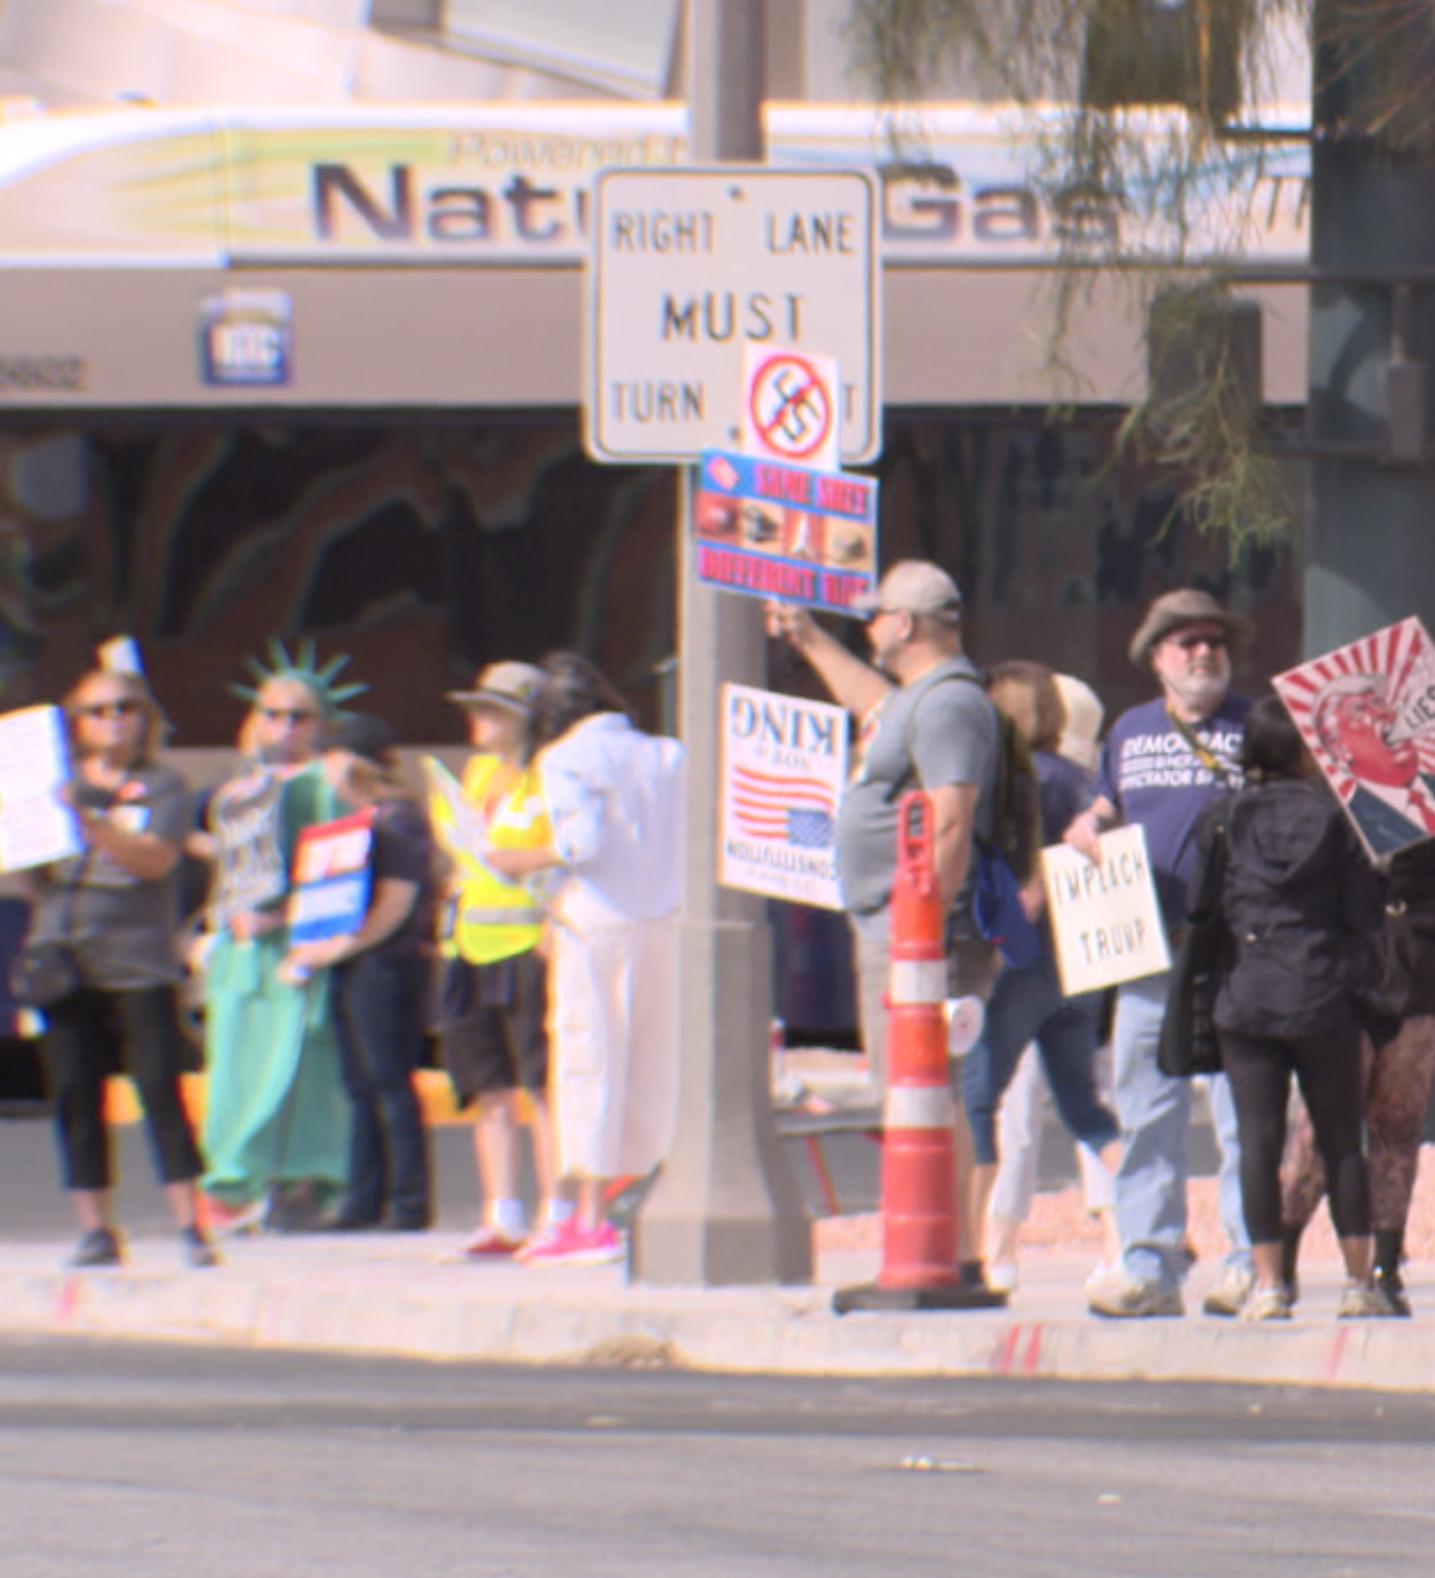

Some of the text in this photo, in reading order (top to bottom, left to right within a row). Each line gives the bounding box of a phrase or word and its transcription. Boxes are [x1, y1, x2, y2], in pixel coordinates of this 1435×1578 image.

[612, 211, 855, 254] RIGHT LANE
[661, 292, 805, 343] MUST
[611, 382, 703, 422] TURN
[731, 696, 836, 755] KING
[1079, 917, 1147, 967] TRUMP
